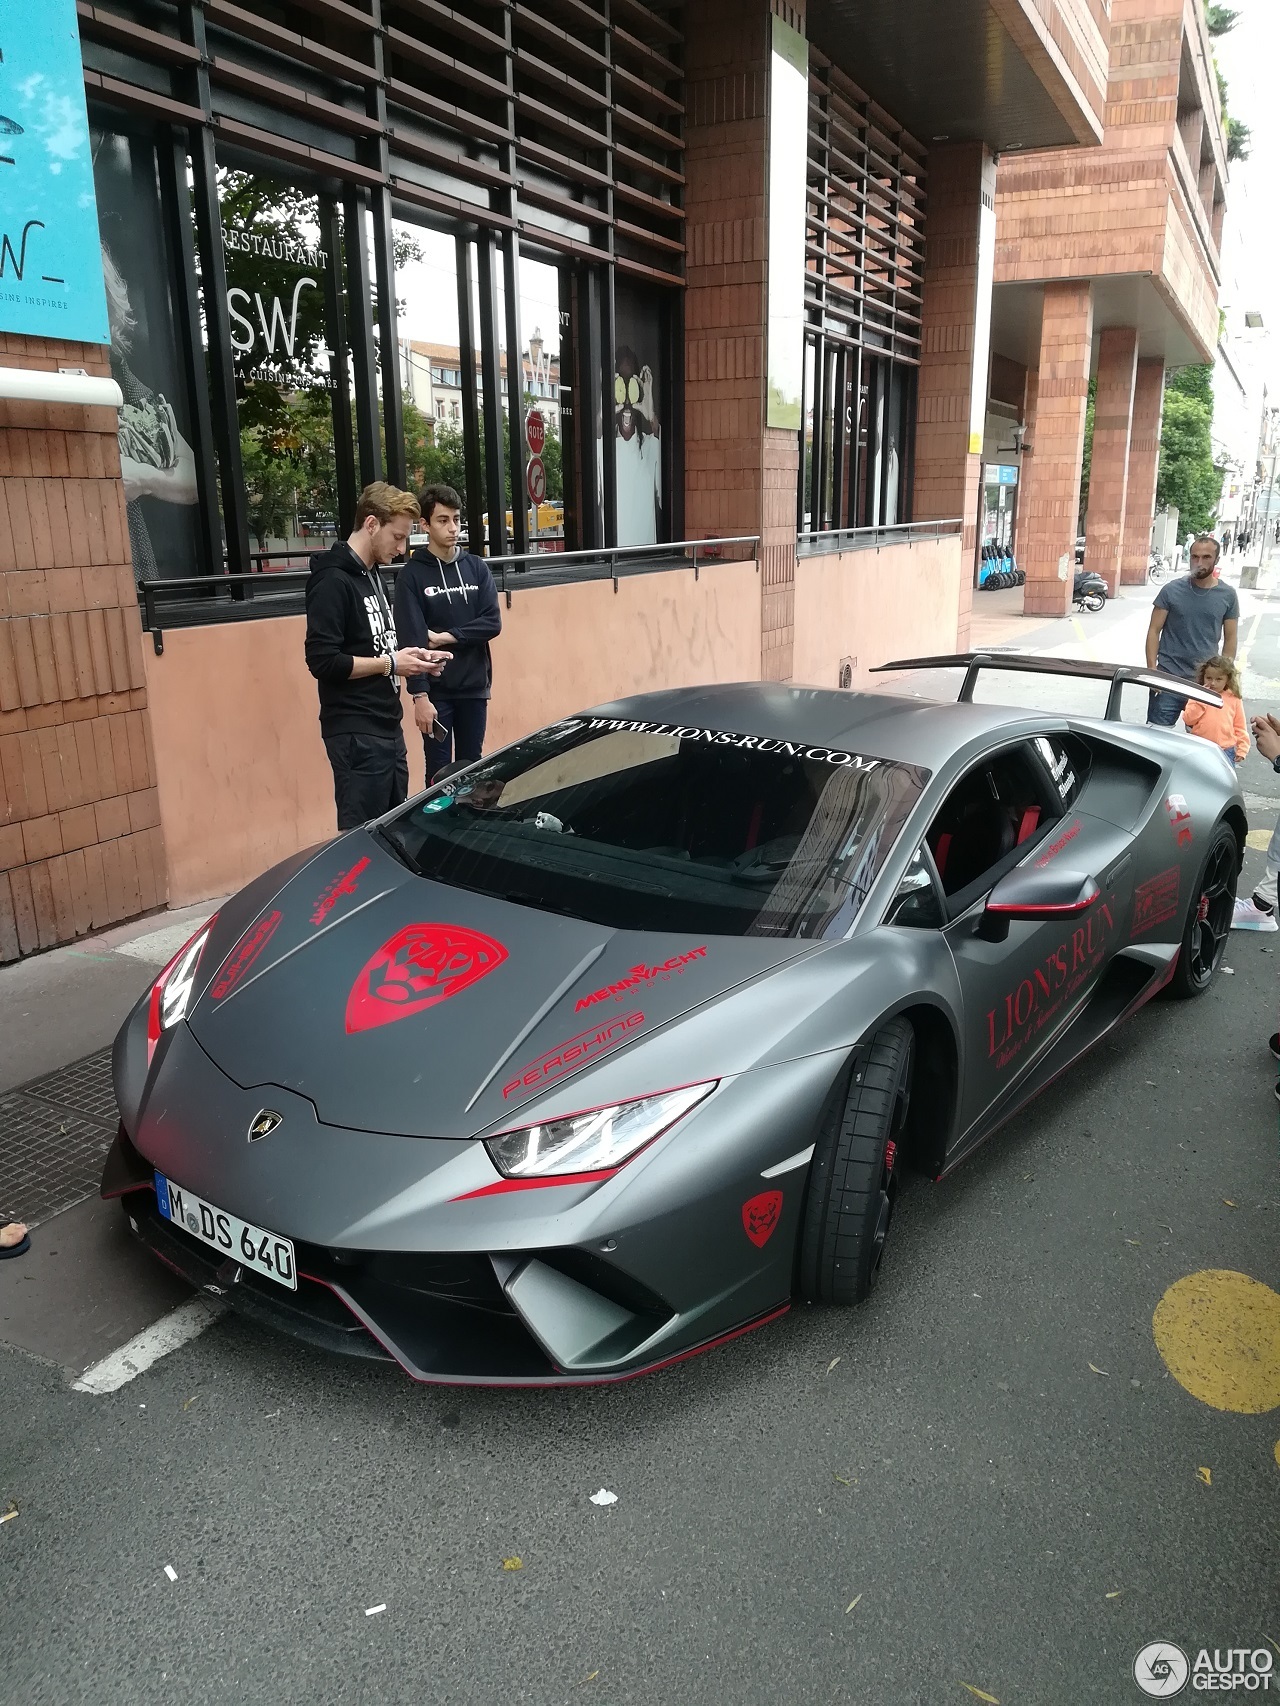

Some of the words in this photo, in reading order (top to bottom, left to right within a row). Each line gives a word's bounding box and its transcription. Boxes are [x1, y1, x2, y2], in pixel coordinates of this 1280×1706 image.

[221, 228, 329, 269] RESTAURANT
[249, 369, 292, 383] CUISINE
[574, 945, 708, 1013] MENNYACHT
[614, 968, 685, 1003] GROUP
[502, 1011, 646, 1100] PERSHING
[168, 1184, 185, 1224] M
[198, 1202, 233, 1250] DS
[240, 1226, 293, 1281] 640
